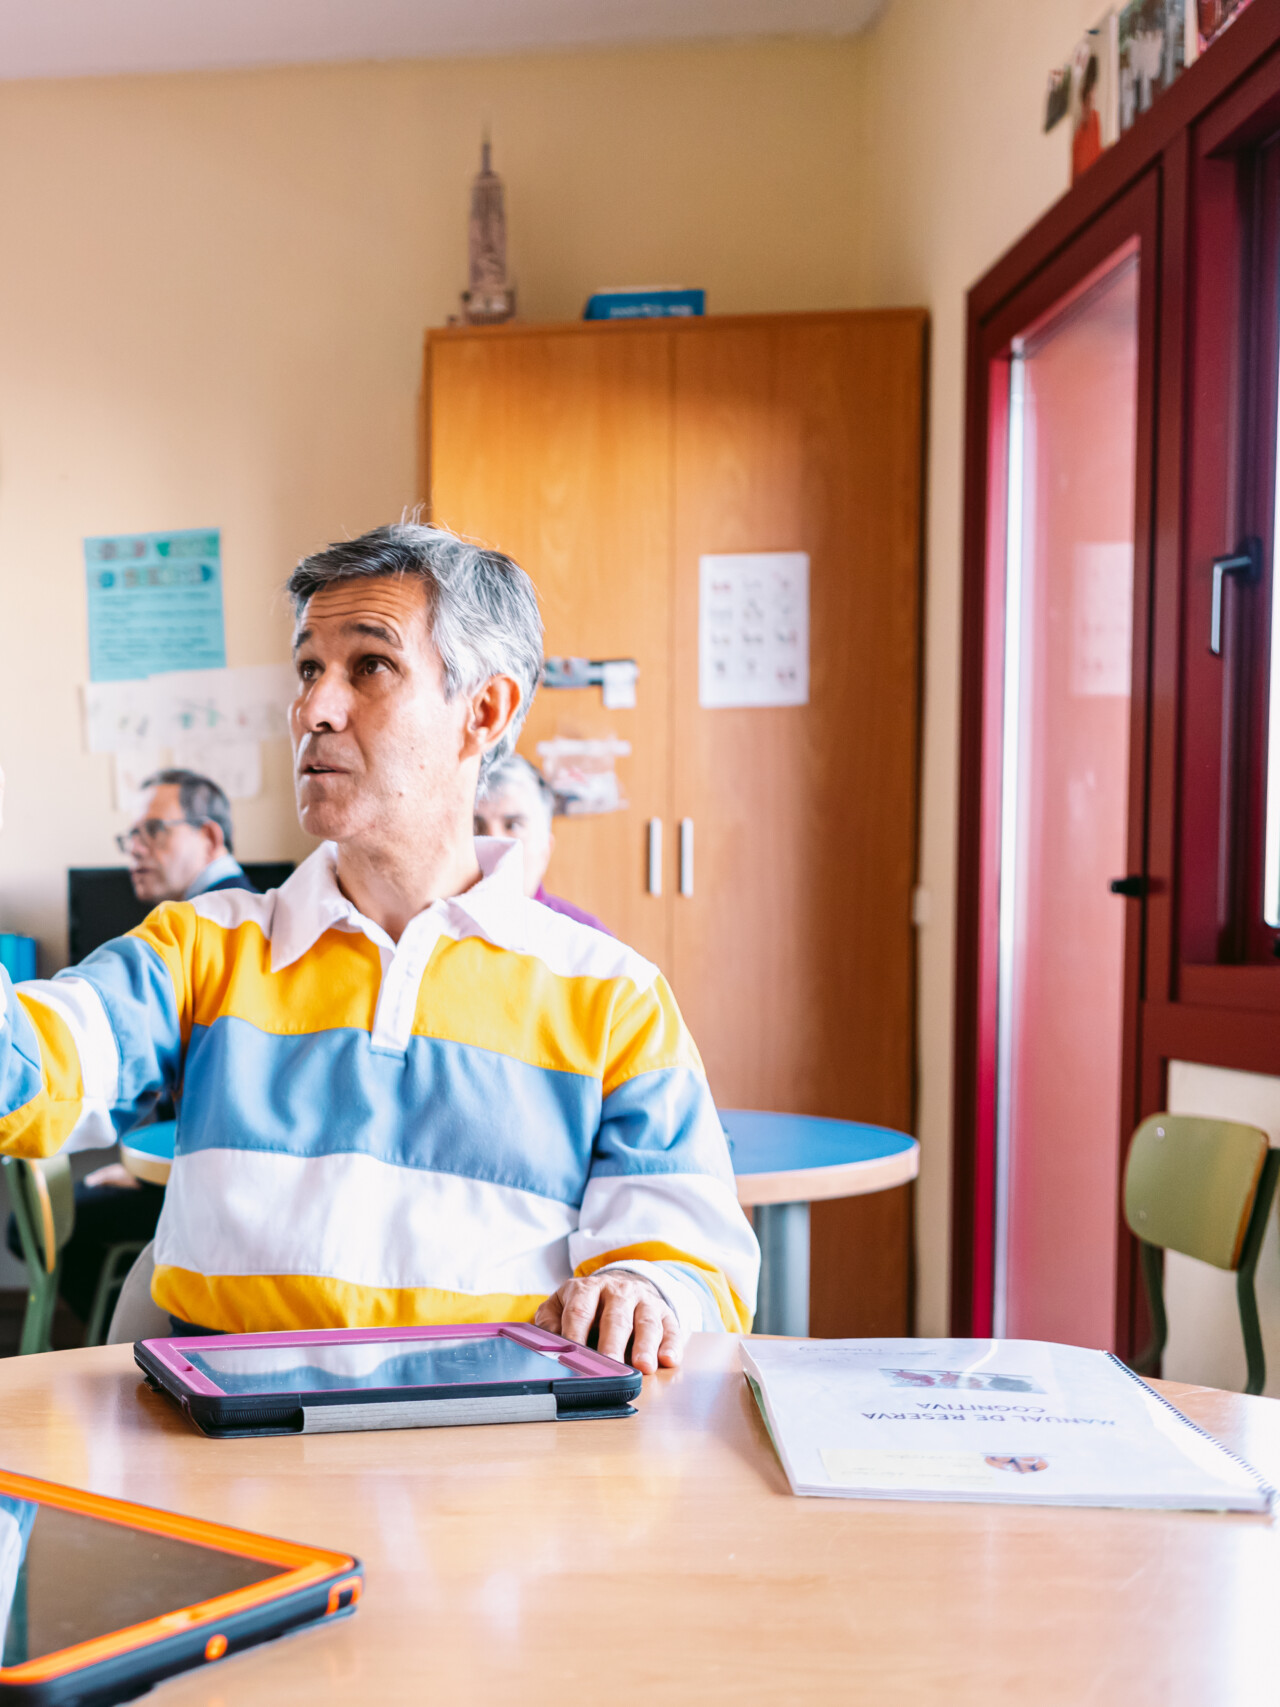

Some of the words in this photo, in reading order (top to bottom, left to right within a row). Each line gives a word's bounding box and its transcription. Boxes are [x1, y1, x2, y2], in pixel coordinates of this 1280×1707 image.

[915, 1402, 1046, 1413] COGNITIVA
[860, 1411, 966, 1421] RESERVA
[973, 1413, 1006, 1422] DE
[1011, 1414, 1116, 1426] MANUAL
